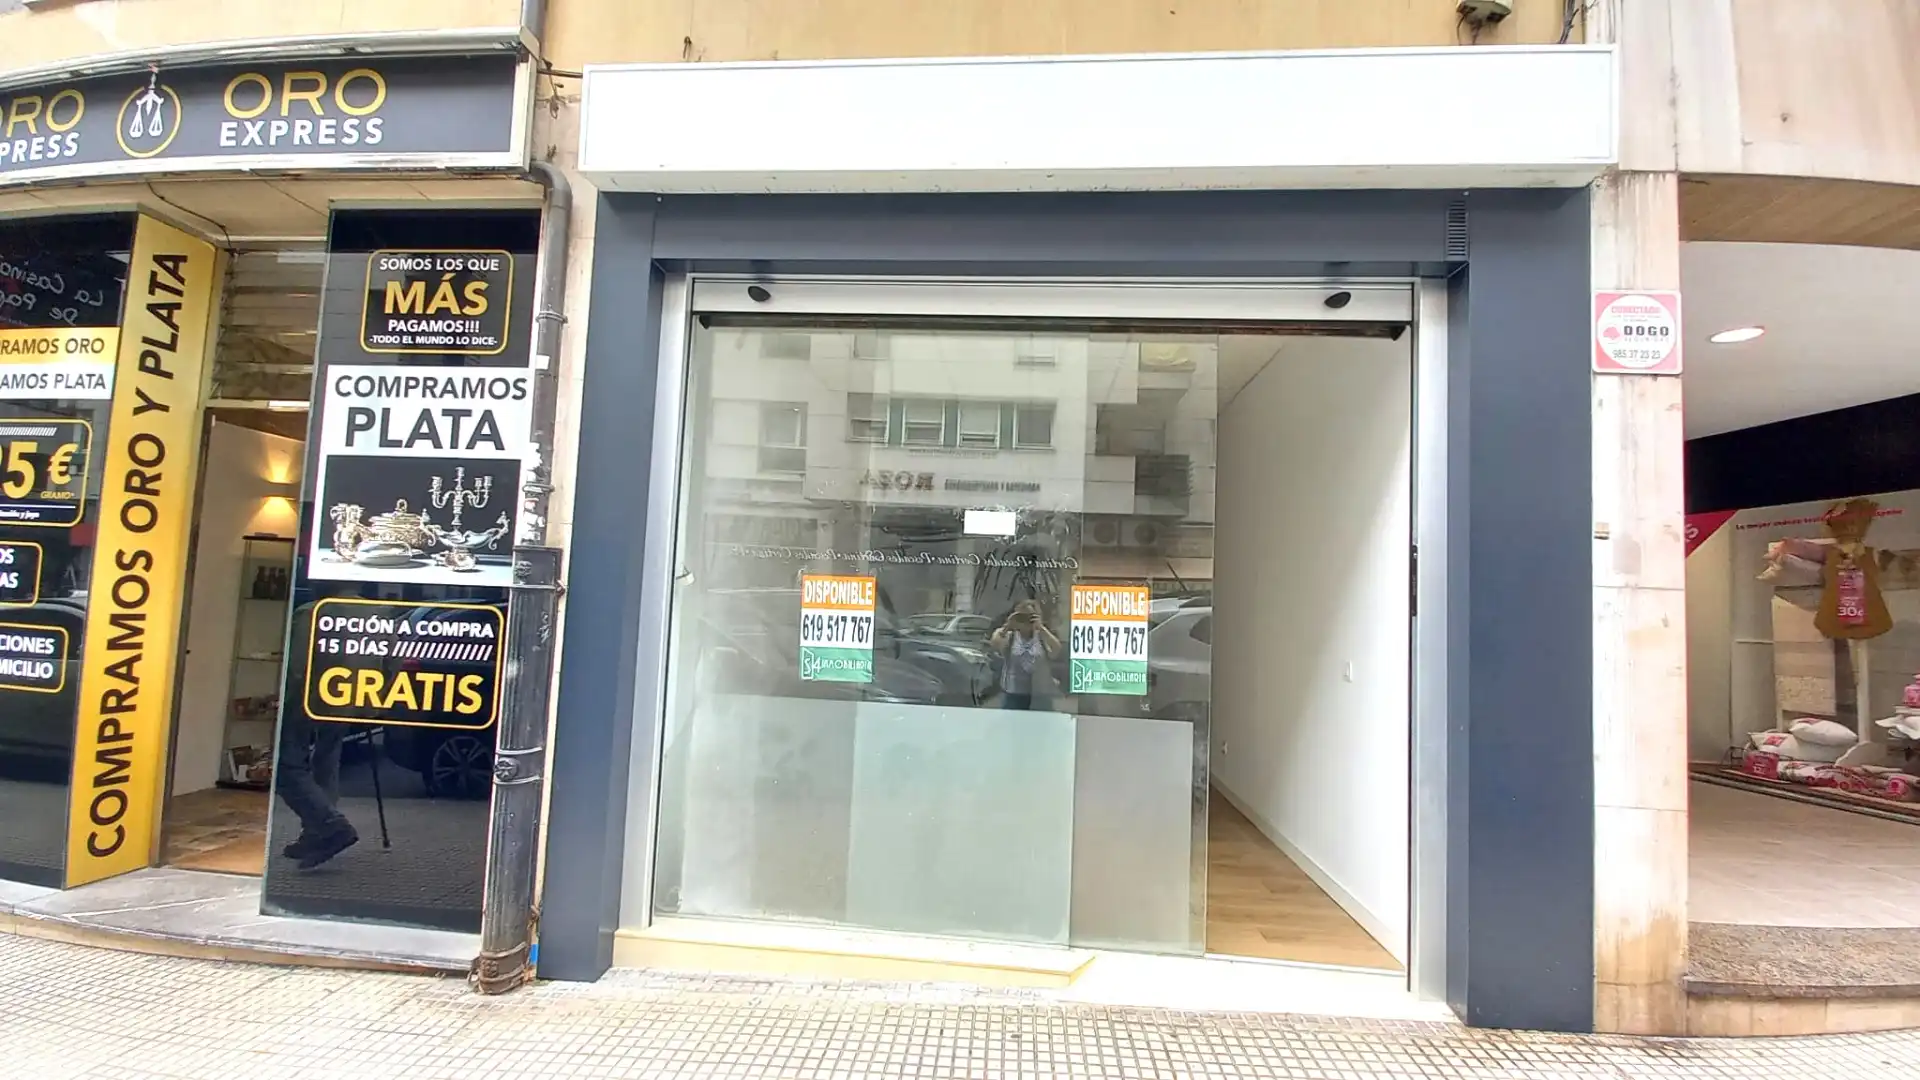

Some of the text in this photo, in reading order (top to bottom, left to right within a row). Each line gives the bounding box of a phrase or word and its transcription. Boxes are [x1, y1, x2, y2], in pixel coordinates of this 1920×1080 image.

[224, 69, 387, 119] ORO
[0, 89, 85, 137] RO
[219, 117, 384, 147] EXPRESS
[0, 131, 80, 167] PRESS
[379, 258, 500, 272] SOMOS LOS QUE
[384, 273, 489, 316] MÁS
[388, 319, 480, 333] PAGAMOS!!!
[402, 335, 413, 344] EL
[415, 335, 454, 345] MUNDO
[455, 336, 470, 345] LO
[1623, 325, 1669, 336] DOGO
[0, 338, 105, 355] RAMOS ORO
[0, 373, 106, 389] AMOS PLATA
[335, 375, 527, 401] COMPRAMOS
[345, 407, 505, 451] PLATA
[0, 442, 38, 499] 5
[87, 254, 188, 858] COMPRAMOS ORO Y PLATA
[804, 580, 873, 606] DISPONIBLE
[1073, 590, 1145, 616] DISPONIBLE
[318, 614, 495, 638] OPCIÓN A COMPRA
[802, 613, 871, 643] 619 517 767
[1073, 625, 1145, 655] 619 517 767
[318, 636, 389, 656] 15 DÍAS
[318, 666, 484, 714] GRATIS
